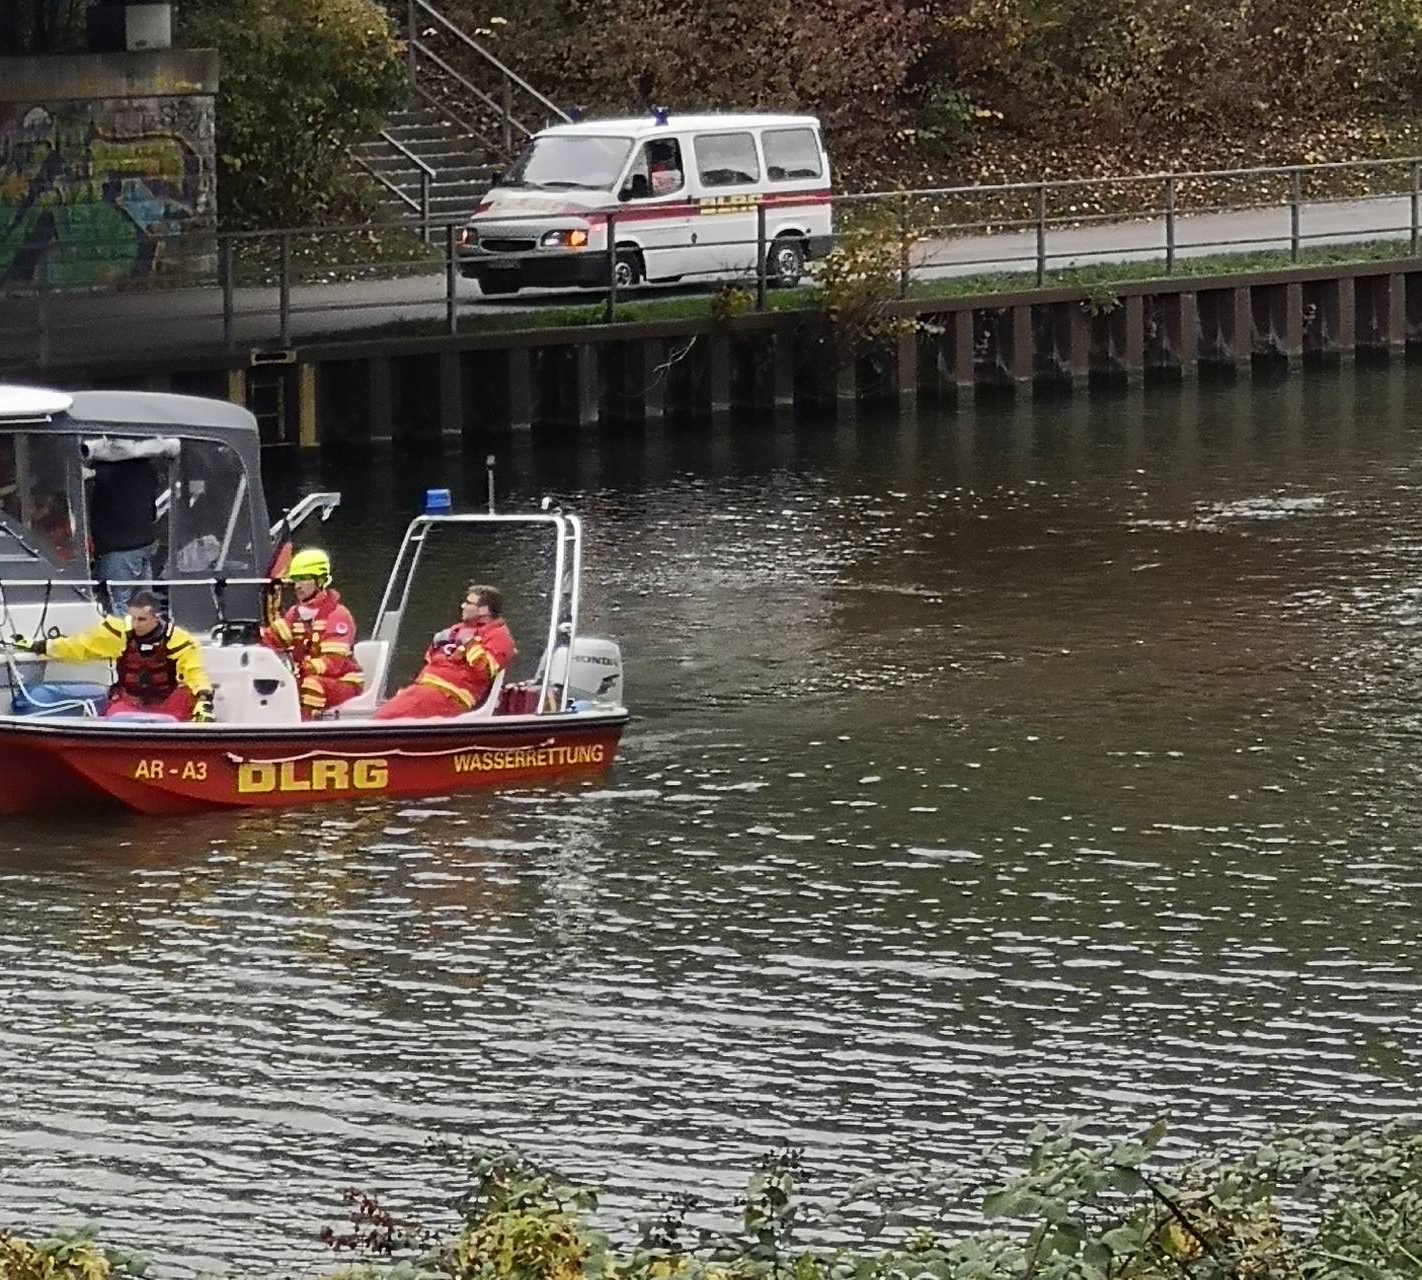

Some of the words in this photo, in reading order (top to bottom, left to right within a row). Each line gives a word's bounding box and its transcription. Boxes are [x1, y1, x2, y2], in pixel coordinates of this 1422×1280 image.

[134, 760, 164, 779] AR
[182, 761, 208, 780] A3
[454, 744, 604, 773] WASSERRETTUNG
[238, 759, 389, 793] DLRG
